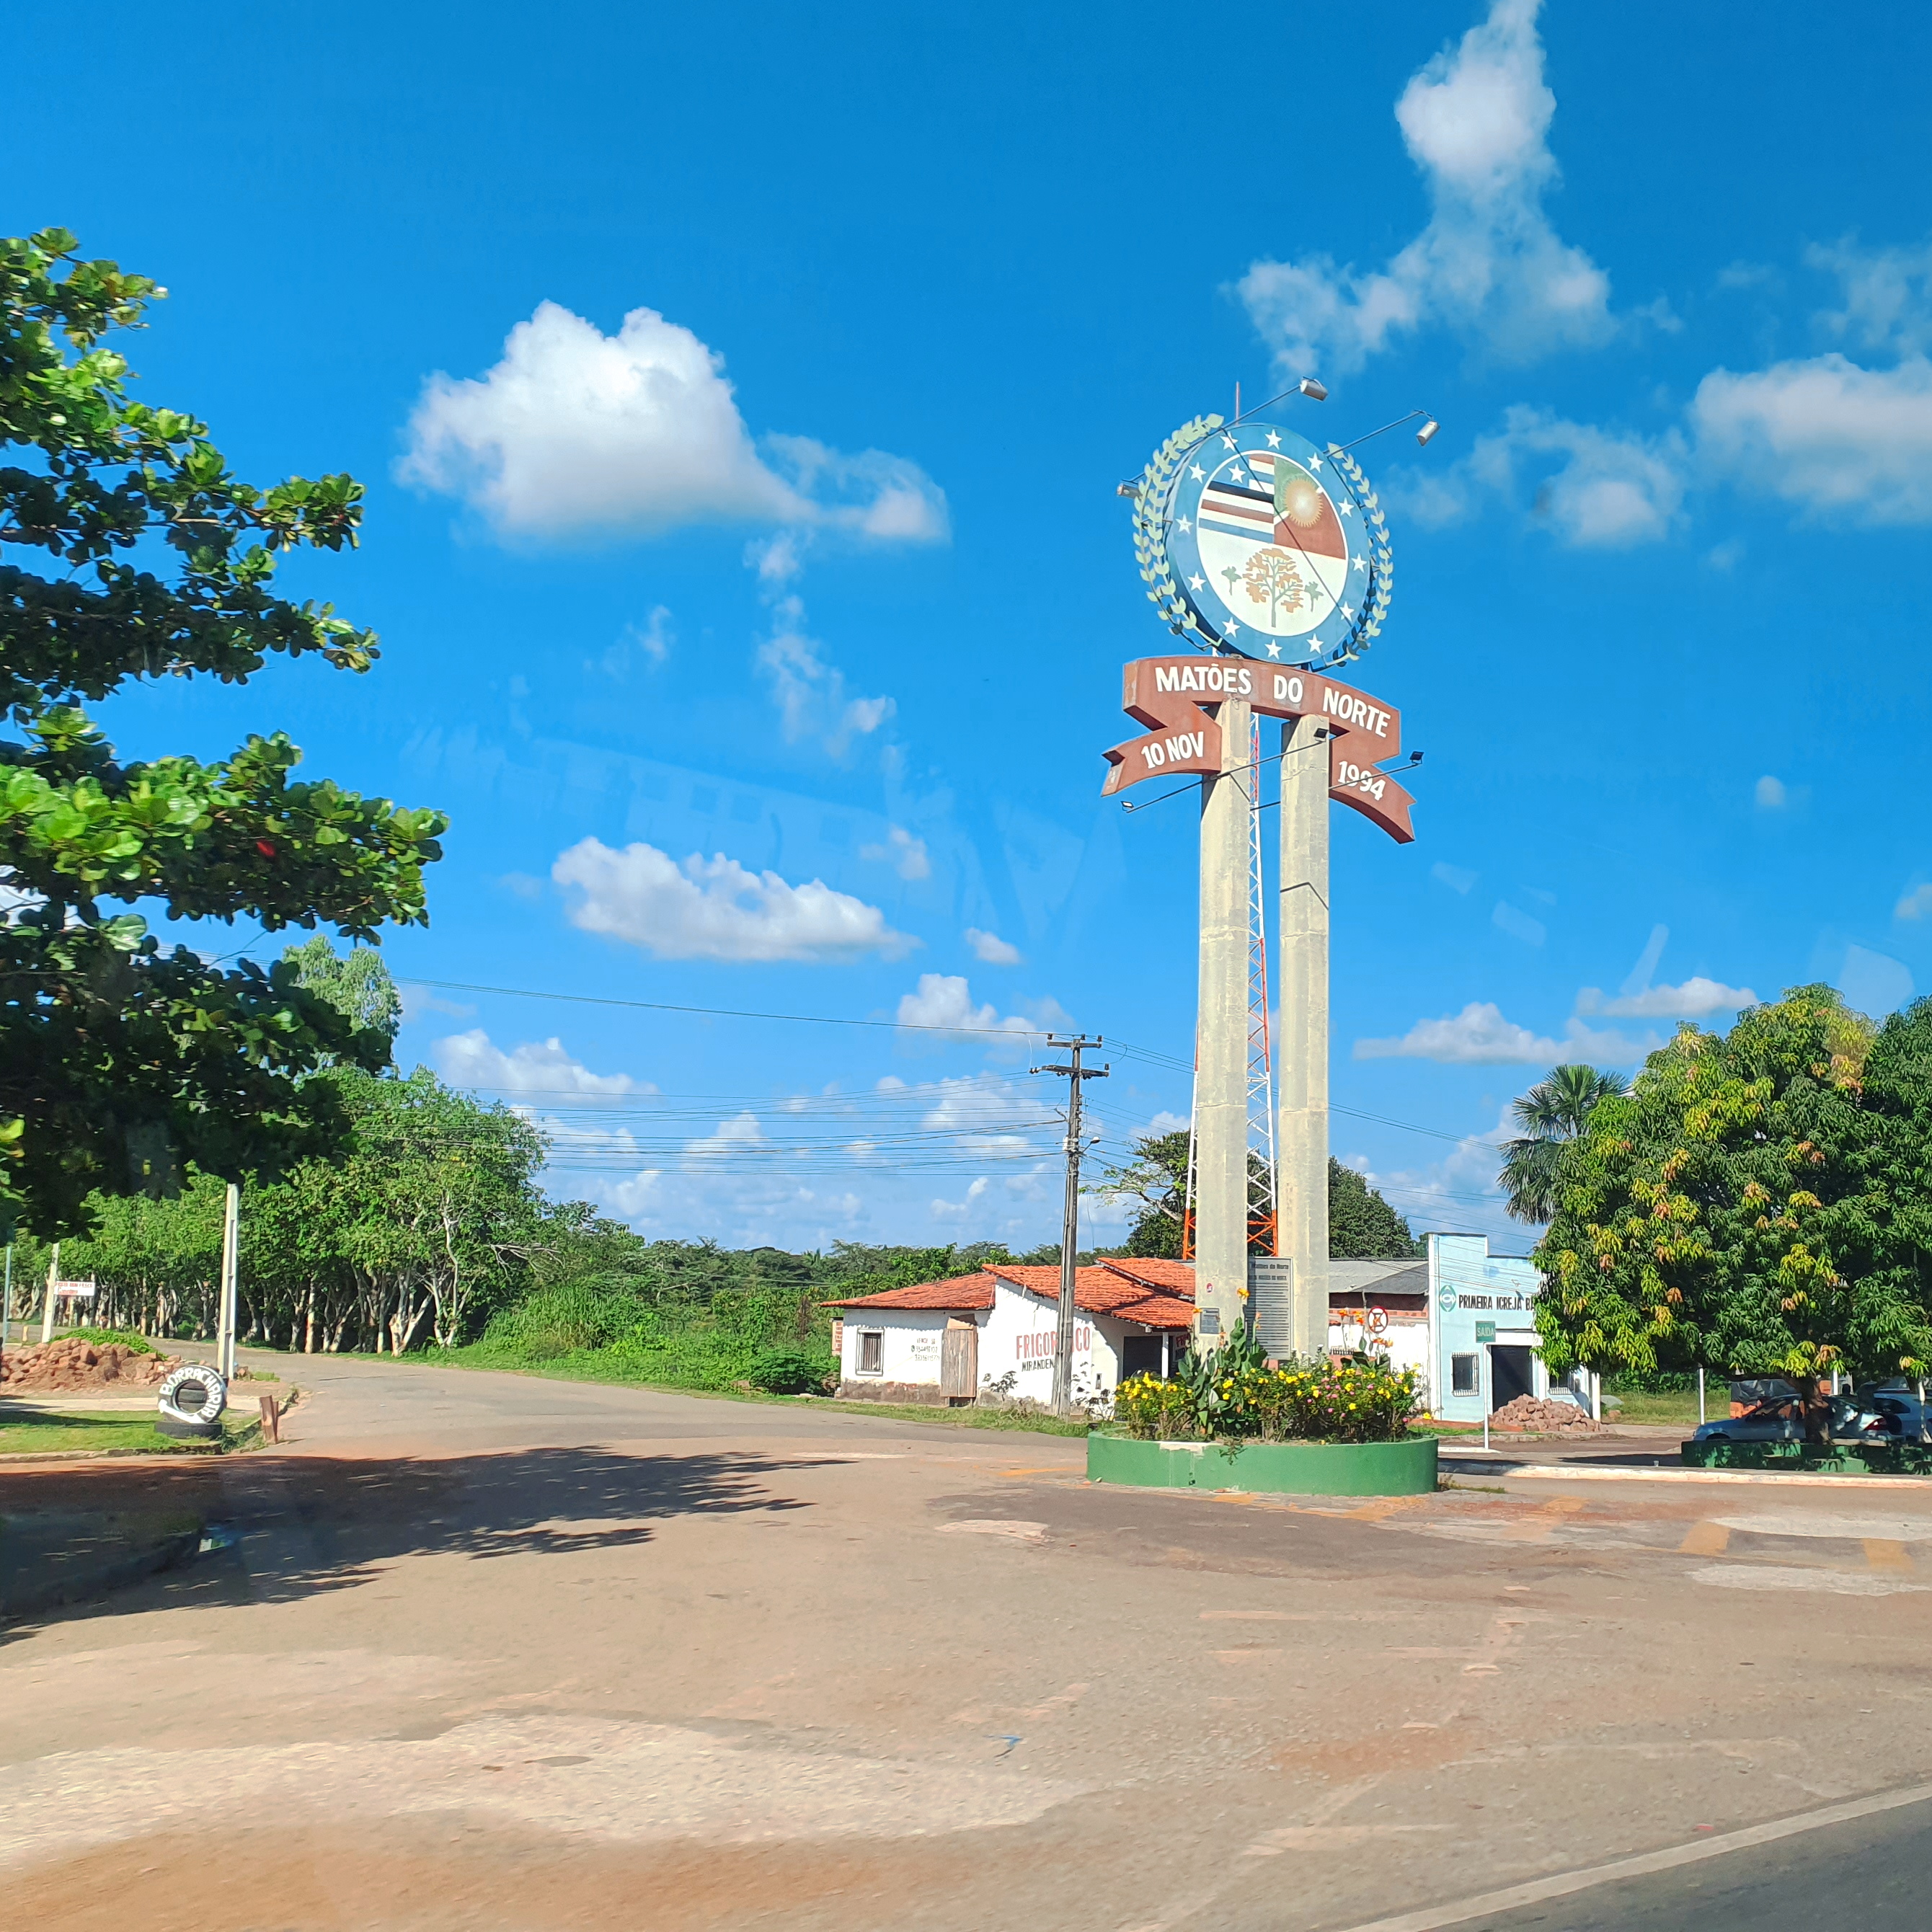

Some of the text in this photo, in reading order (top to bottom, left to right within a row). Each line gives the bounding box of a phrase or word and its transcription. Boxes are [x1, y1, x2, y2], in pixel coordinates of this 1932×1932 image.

[1155, 663, 1391, 738] MATÕES DO NORTE
[1140, 731, 1204, 769] 10 NOV
[1337, 761, 1386, 801] 1994
[1458, 1294, 1492, 1310] PRIMEIRA
[1525, 1298, 1536, 1311] BA
[1016, 1326, 1091, 1360] FRIGORCO
[159, 1367, 222, 1418] BORRACHARIA
